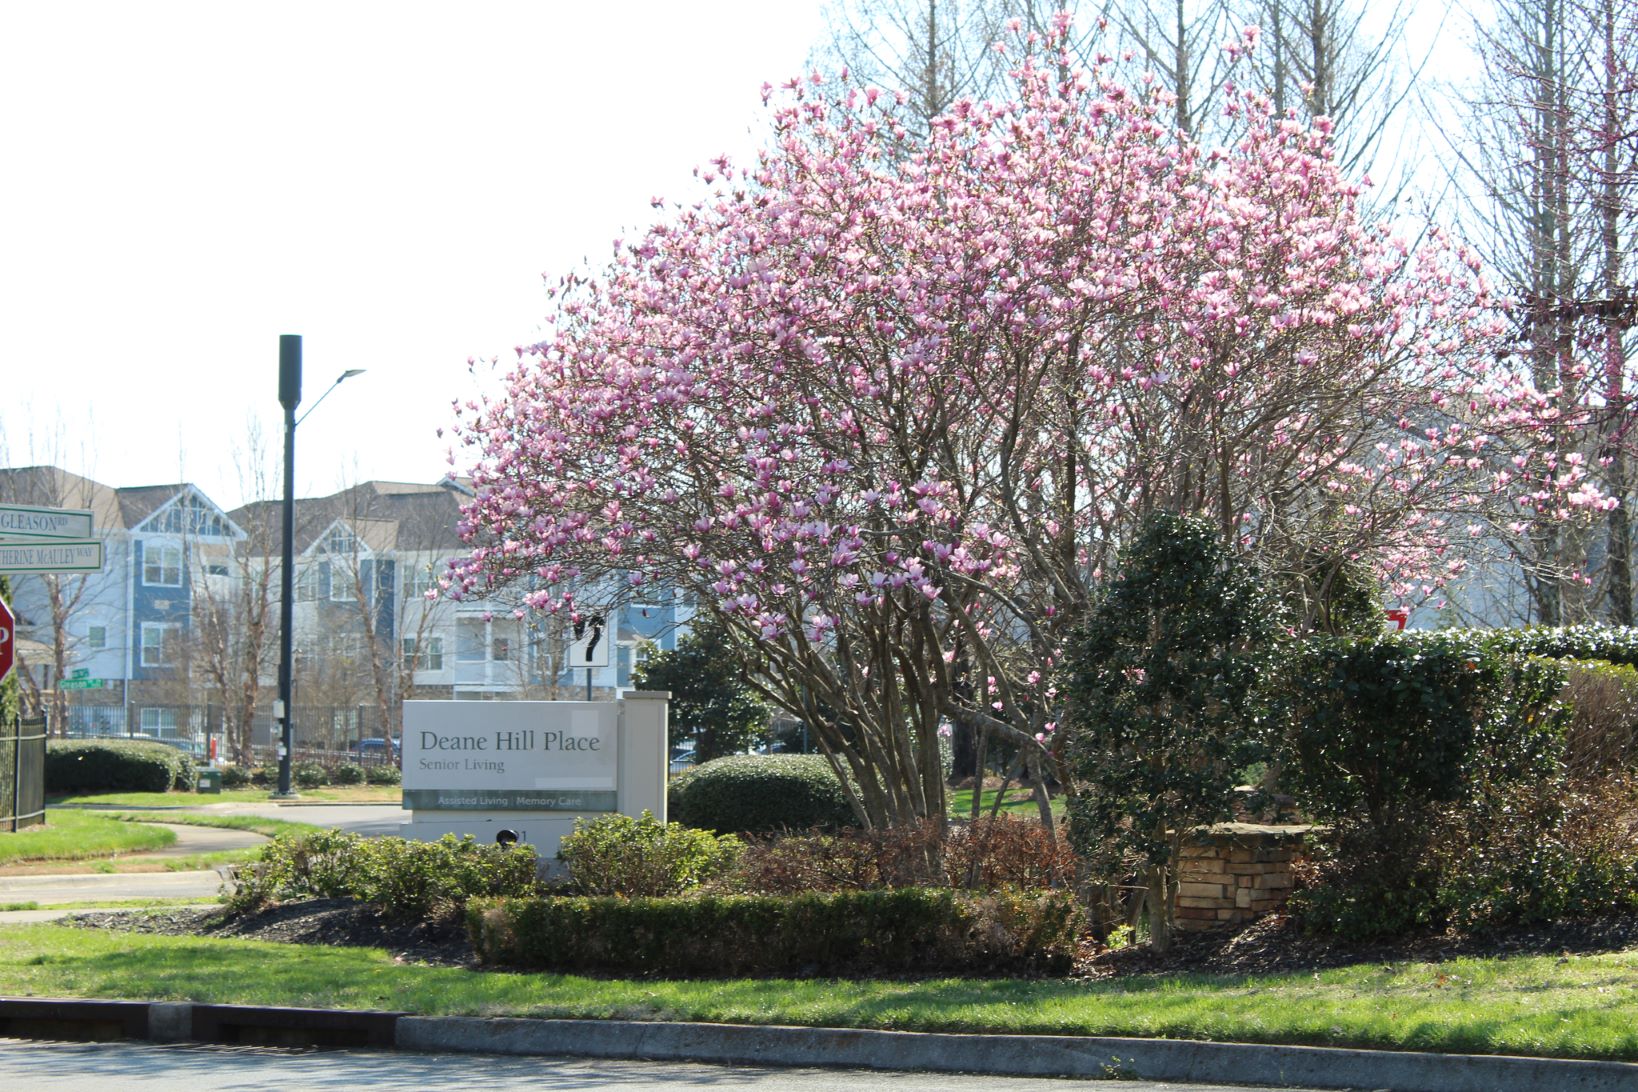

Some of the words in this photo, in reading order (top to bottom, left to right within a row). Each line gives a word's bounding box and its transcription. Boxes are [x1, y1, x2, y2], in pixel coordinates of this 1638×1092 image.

[1, 513, 57, 532] GLEASON
[57, 517, 68, 526] RD
[77, 547, 93, 557] WAY
[420, 731, 488, 751] Deane
[496, 730, 534, 751] Hill
[544, 730, 600, 751] Place
[419, 758, 460, 770] Senior
[464, 758, 505, 774] Living
[438, 797, 477, 805] Assisted
[480, 797, 508, 806] Living
[516, 797, 555, 806] Memory
[558, 798, 581, 806] Care
